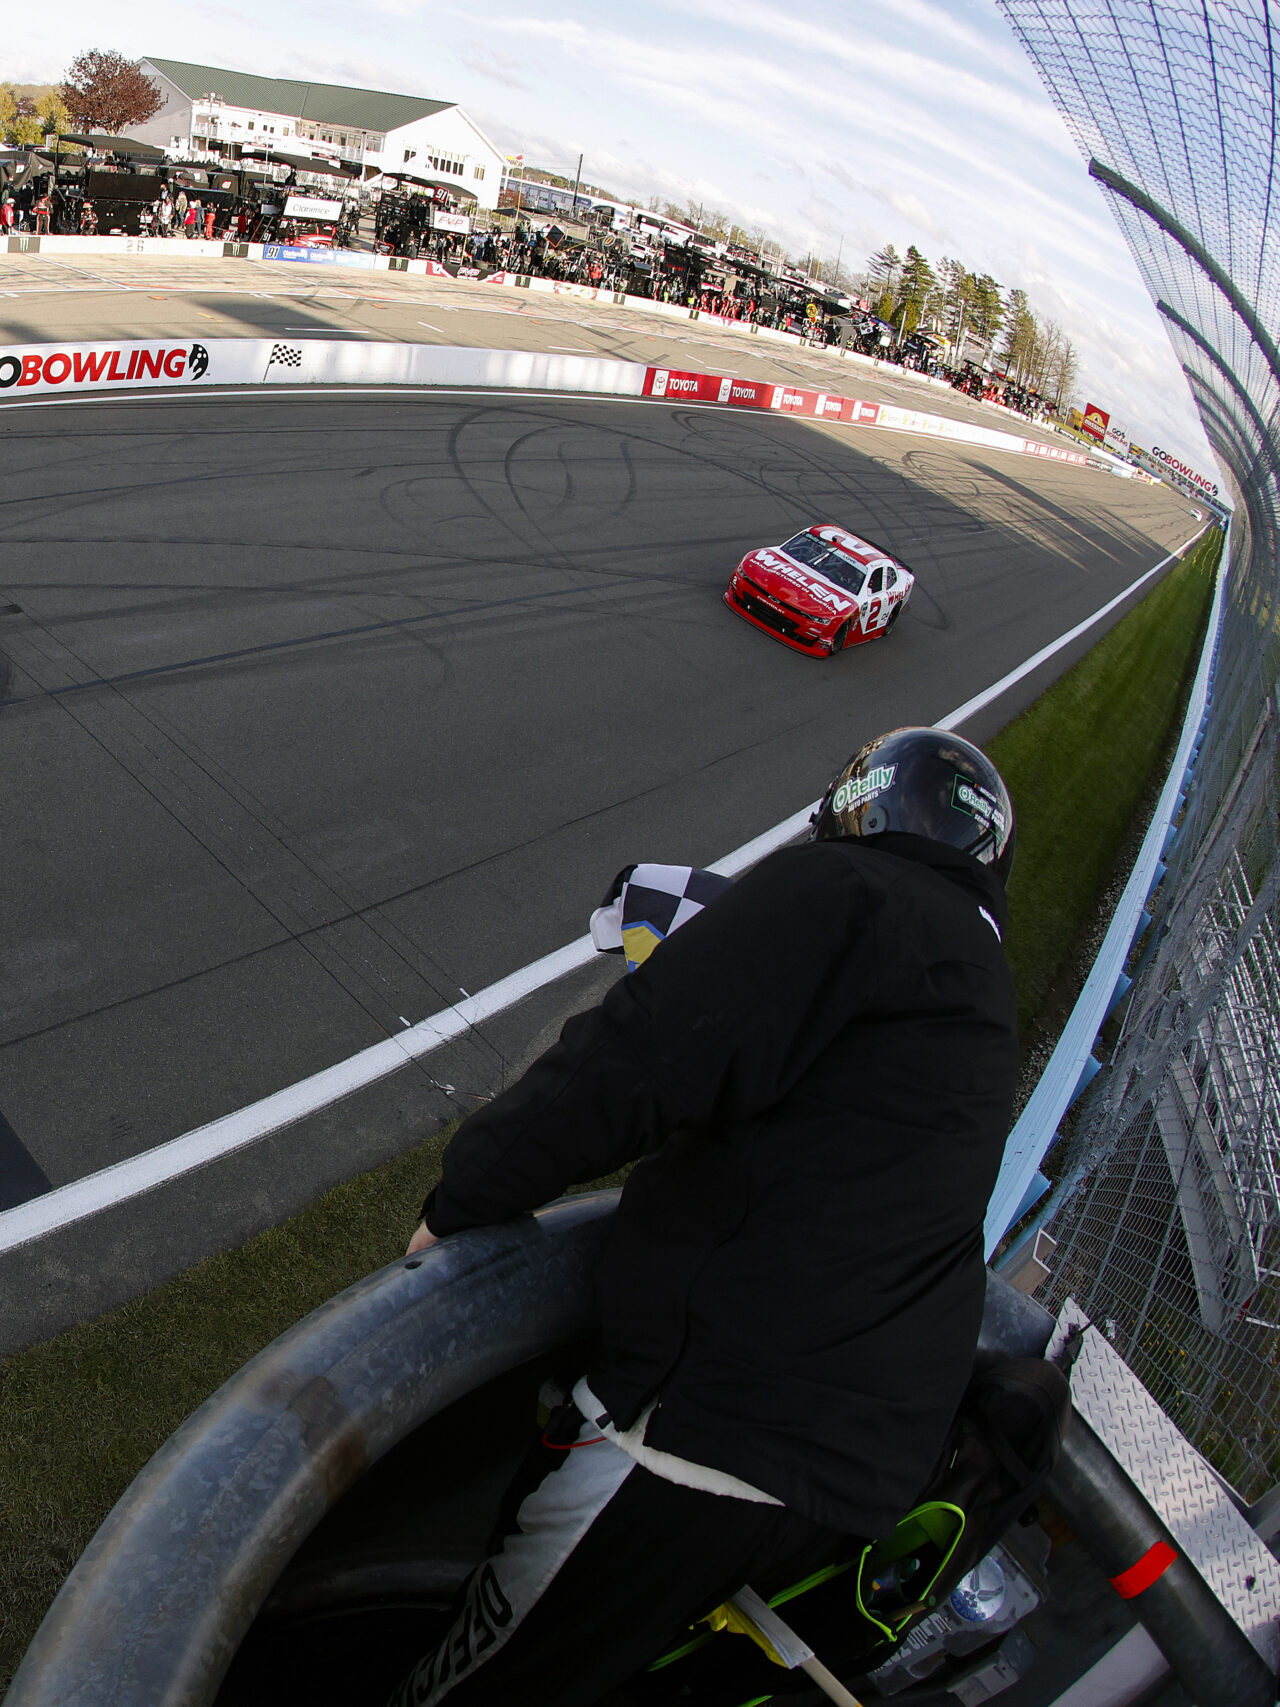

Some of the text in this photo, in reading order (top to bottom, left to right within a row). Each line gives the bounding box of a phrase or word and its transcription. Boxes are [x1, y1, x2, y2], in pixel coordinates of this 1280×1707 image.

[293, 202, 331, 215] Clarience
[266, 246, 280, 259] 91
[669, 378, 698, 392] TOYOTA
[732, 386, 755, 399] TOYOTA
[783, 394, 803, 406] TOYOTA
[1152, 447, 1212, 492] GOBOWLING
[842, 554, 857, 565] LOVE
[749, 559, 801, 587] MANUFACTURED
[809, 594, 837, 615] AMERICA
[754, 549, 852, 612] WHELEN
[865, 597, 882, 632] 2
[833, 765, 895, 816] O'Reilly
[959, 784, 991, 816] O'Reilly
[848, 791, 879, 813] AUTO PARTS
